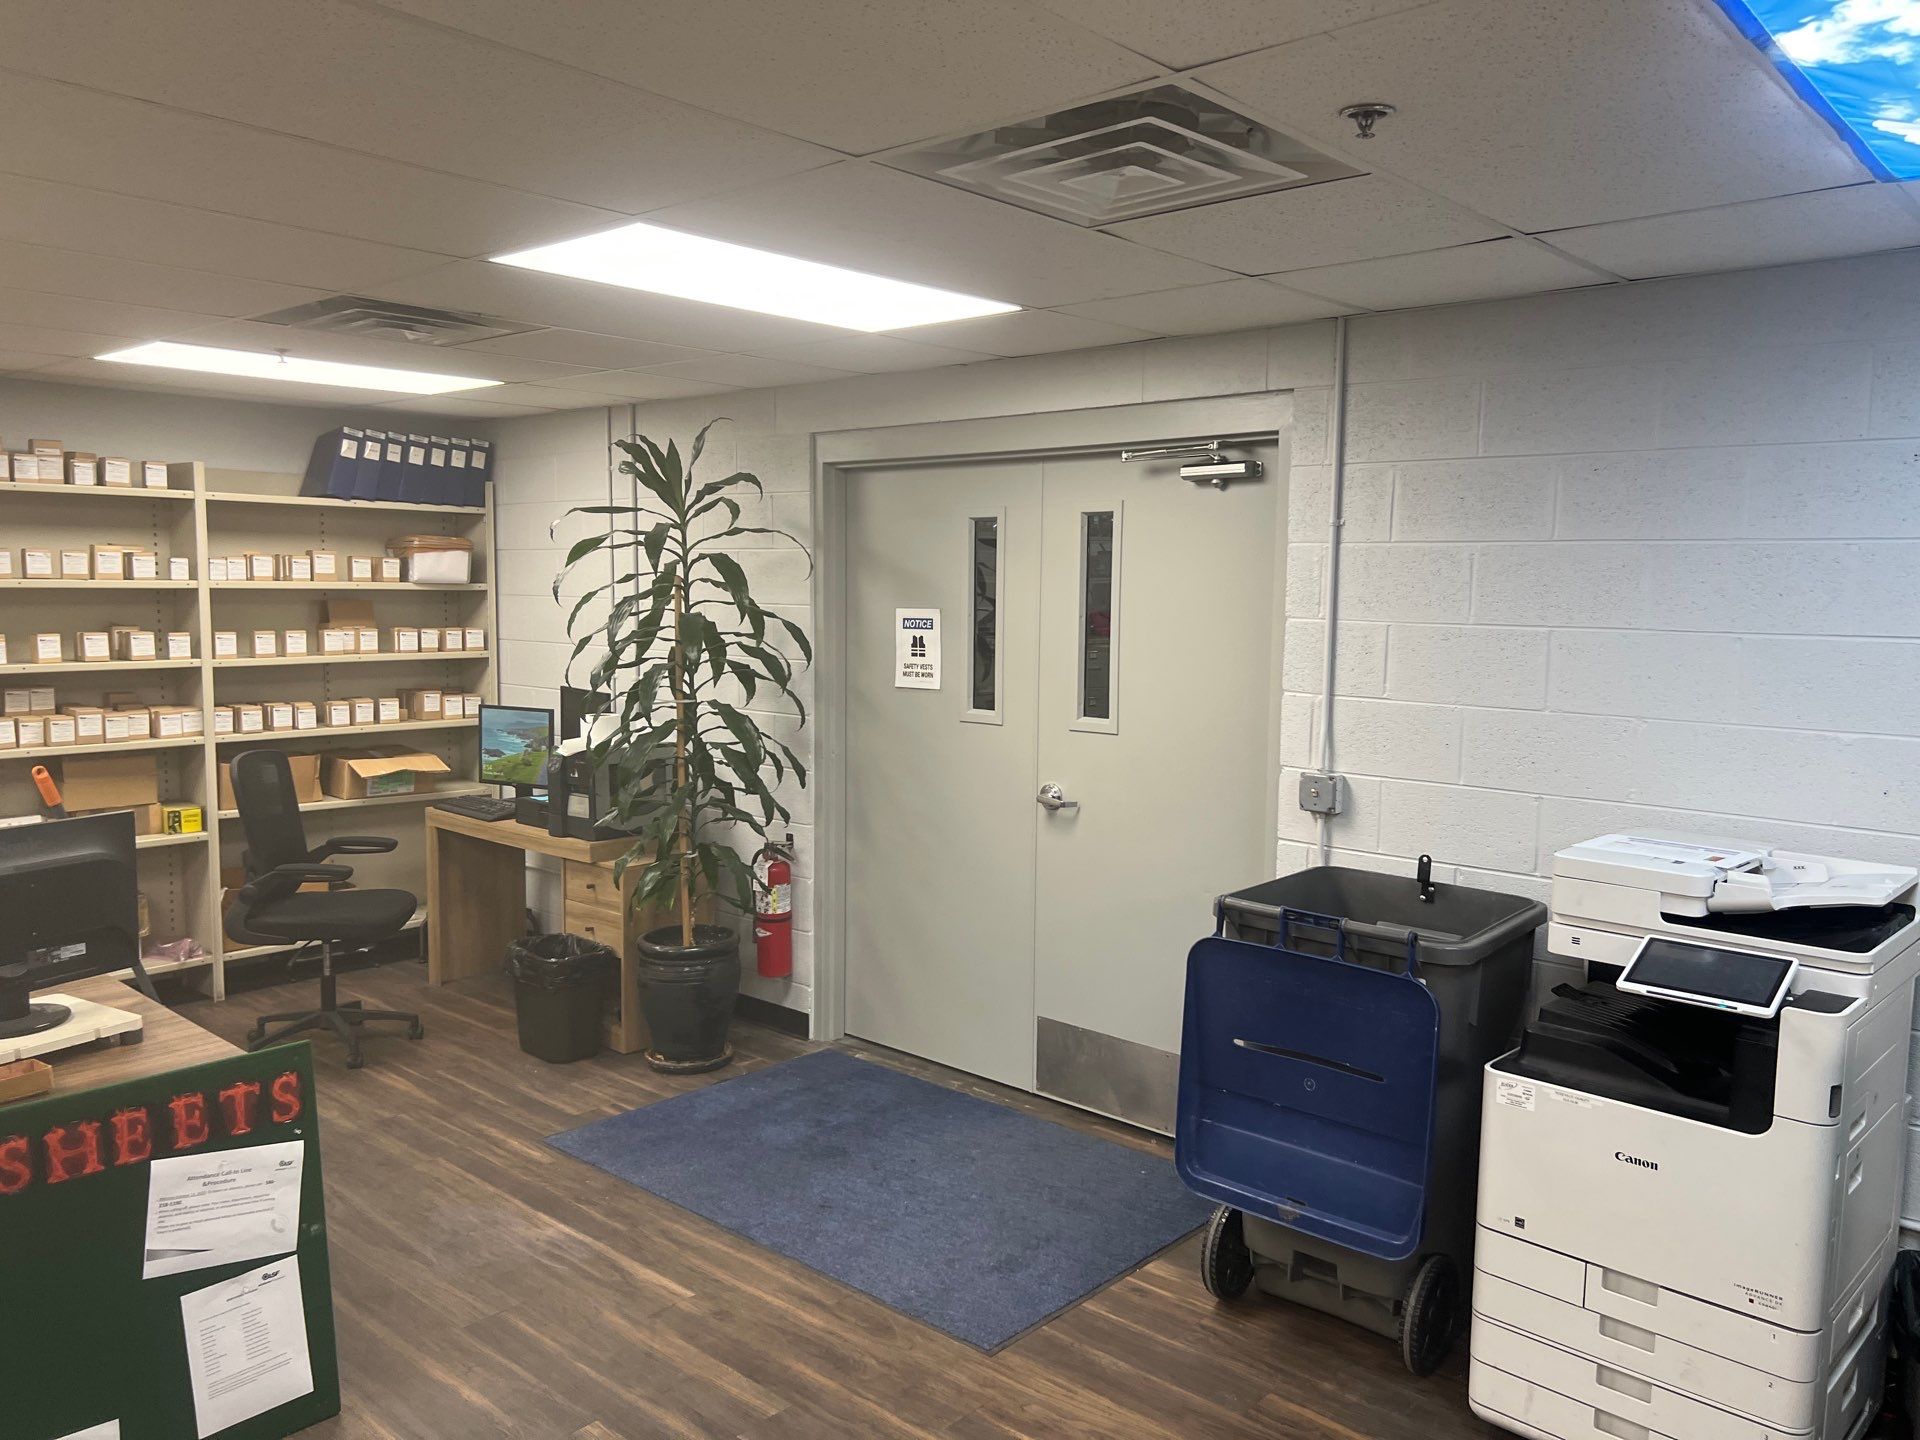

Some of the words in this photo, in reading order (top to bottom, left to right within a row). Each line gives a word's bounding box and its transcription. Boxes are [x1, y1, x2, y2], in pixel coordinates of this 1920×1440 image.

[904, 619, 932, 628] NOTICE
[1614, 1151, 1658, 1171] Canon
[186, 1173, 220, 1181] Attendance
